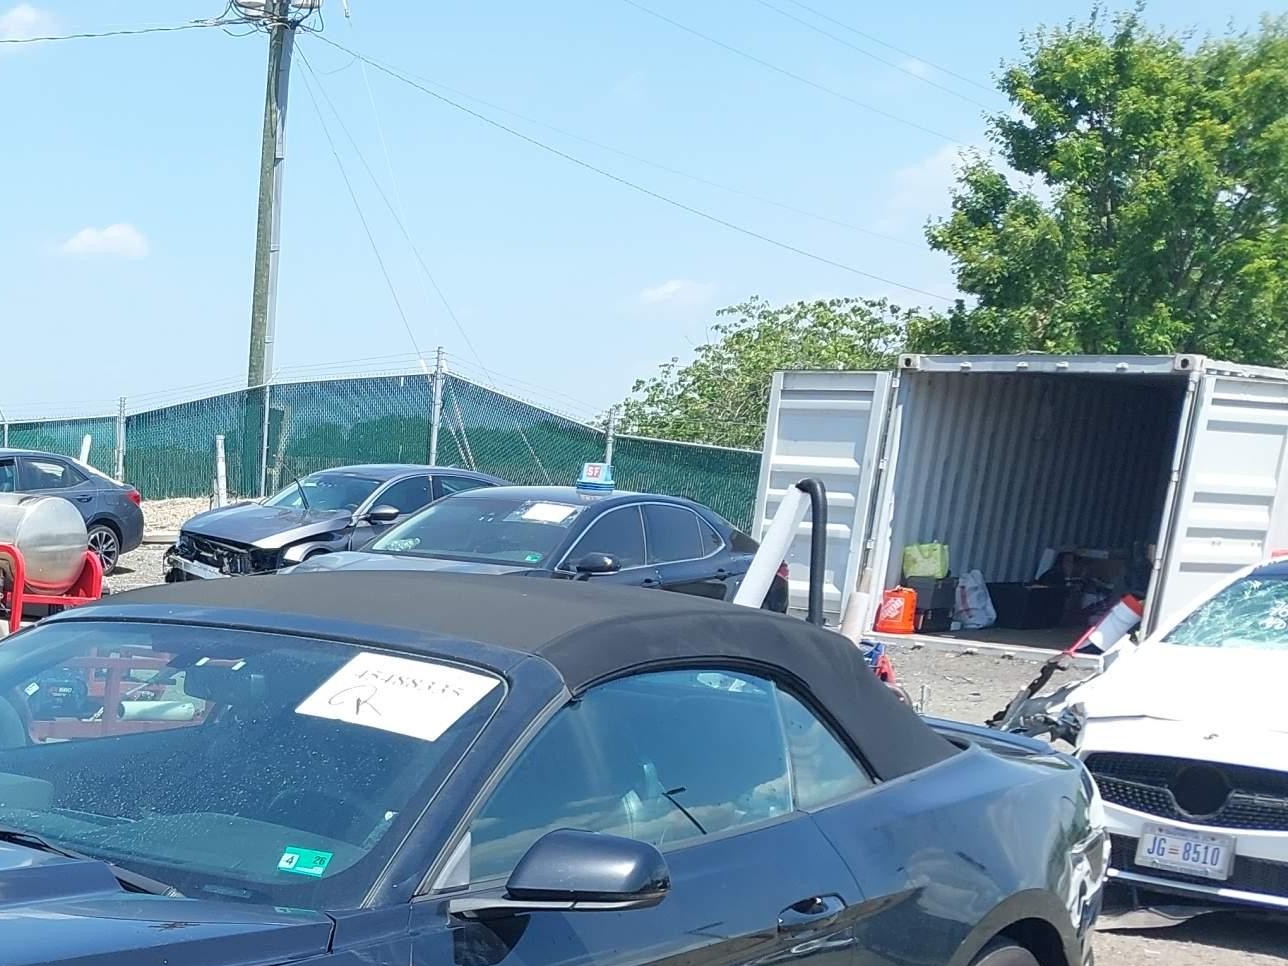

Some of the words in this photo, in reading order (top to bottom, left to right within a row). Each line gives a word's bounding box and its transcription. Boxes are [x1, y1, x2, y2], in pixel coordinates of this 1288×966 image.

[285, 855, 295, 865] 4
[312, 855, 327, 866] 26
[1146, 836, 1167, 857] JG
[1182, 842, 1221, 866] 8510
